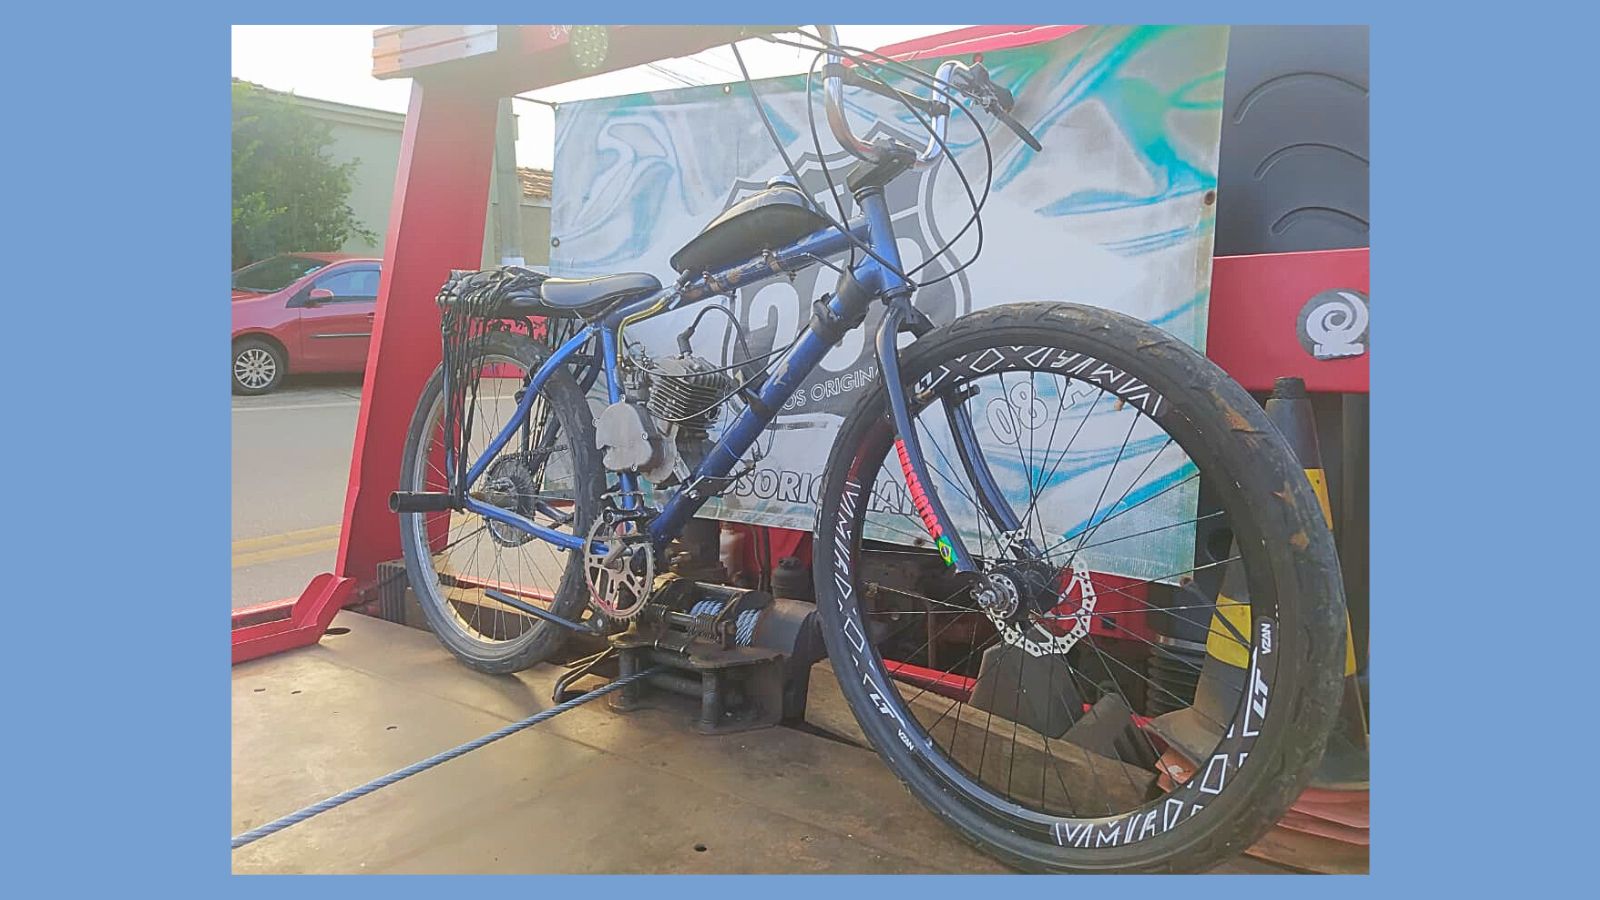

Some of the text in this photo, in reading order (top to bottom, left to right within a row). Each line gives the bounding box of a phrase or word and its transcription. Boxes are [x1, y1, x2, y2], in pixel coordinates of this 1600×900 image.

[811, 366, 880, 401] ORIGIN
[1261, 623, 1271, 654] VZAN
[1253, 667, 1269, 720] LT
[897, 728, 915, 751] VZAN
